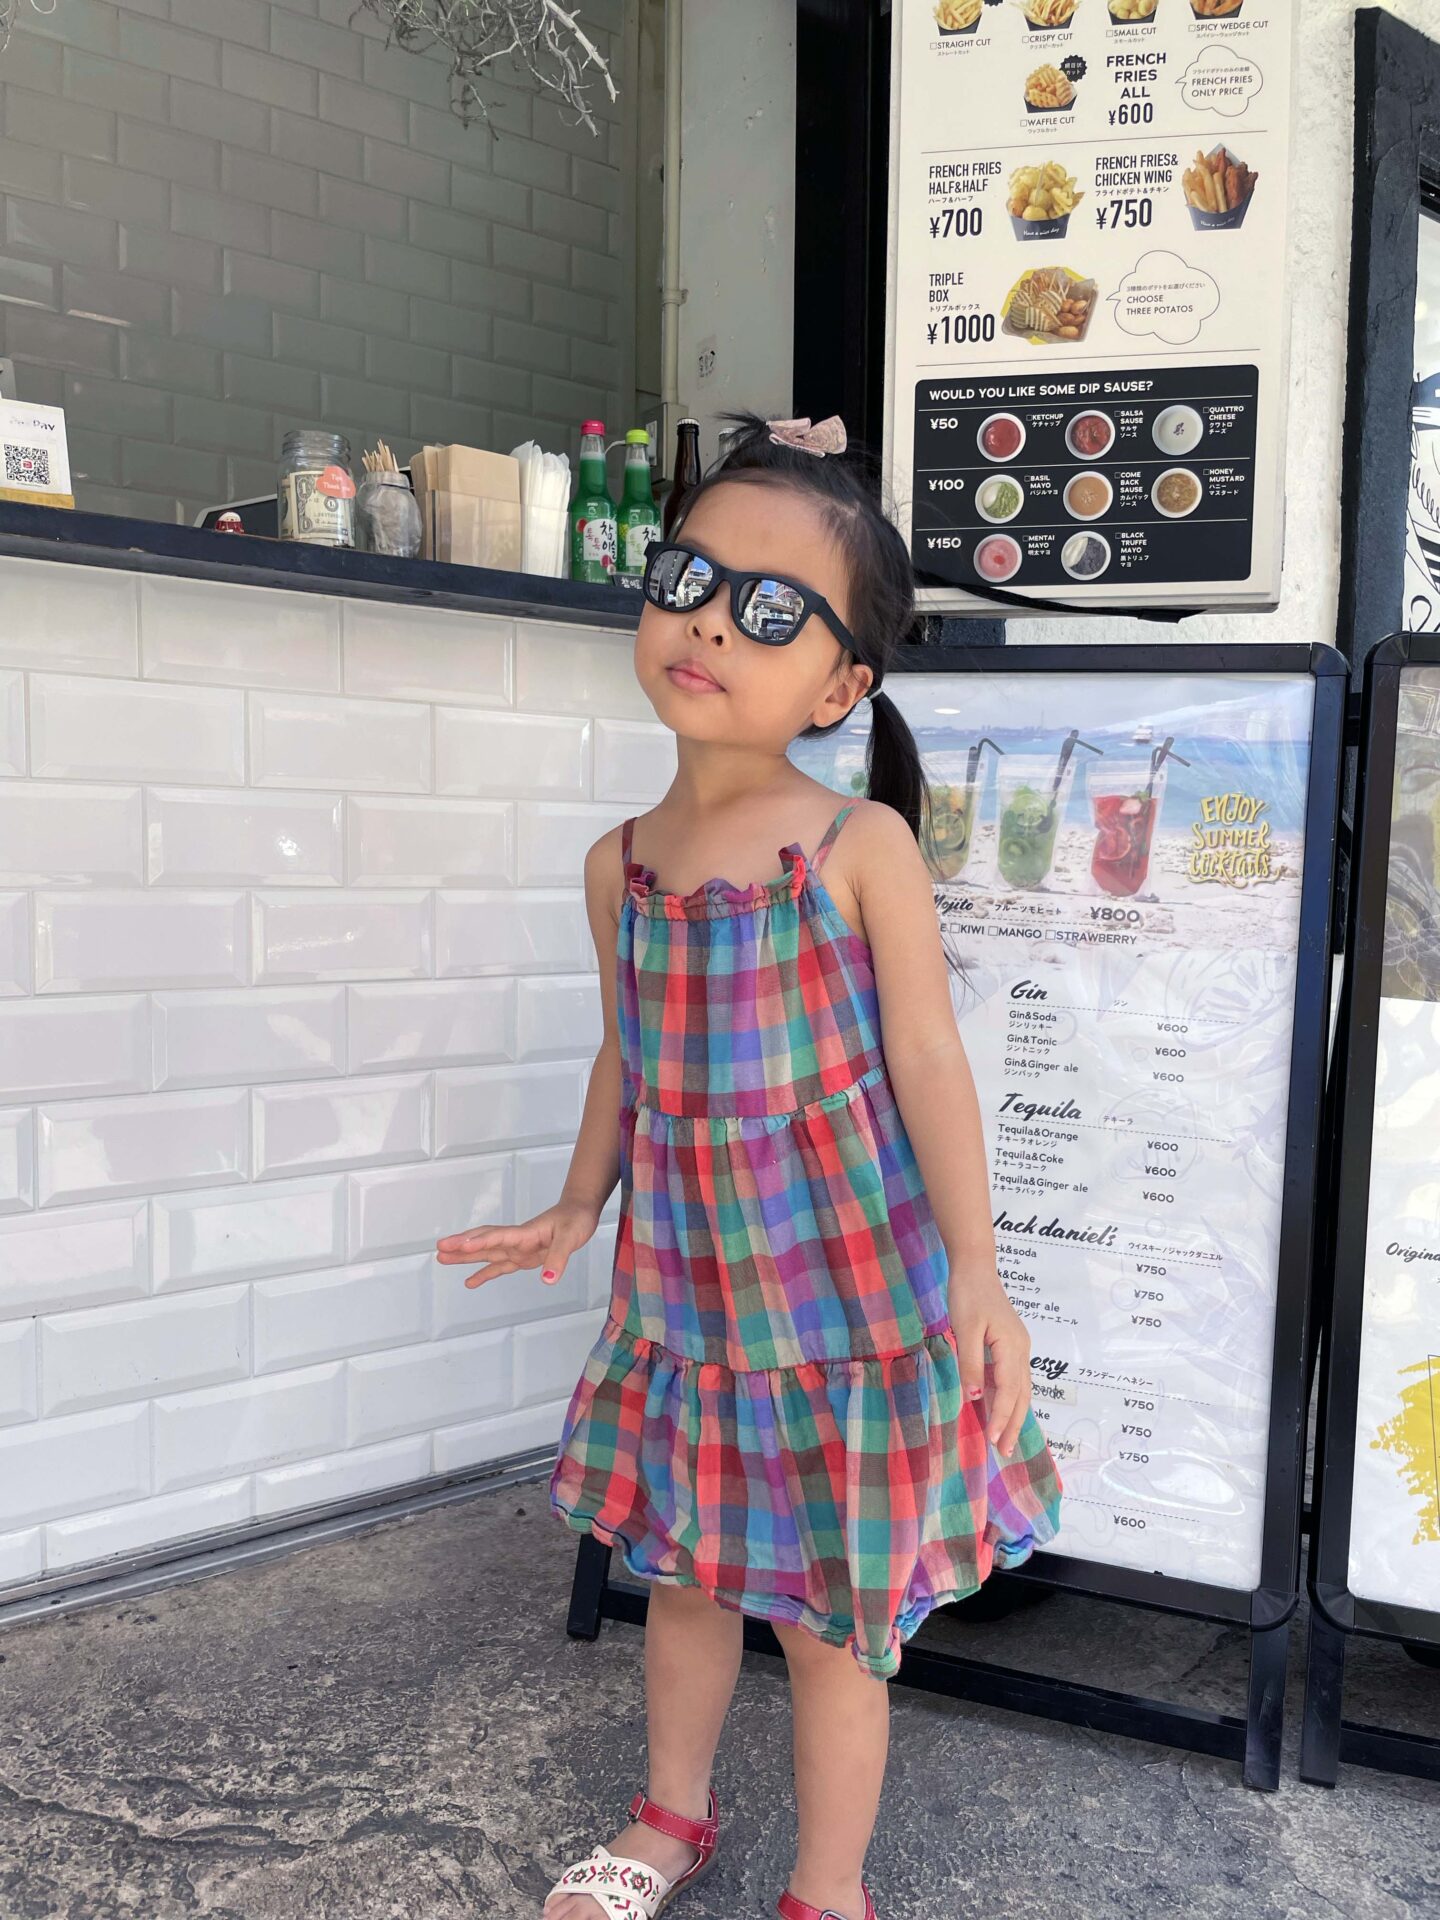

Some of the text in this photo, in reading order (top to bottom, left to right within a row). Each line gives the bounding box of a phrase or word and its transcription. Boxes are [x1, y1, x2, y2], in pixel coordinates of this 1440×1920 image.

[1030, 34, 1055, 43] CRISPY
[1114, 28, 1138, 36] SMALL
[937, 40, 973, 50] STRAIGHT
[1106, 53, 1167, 68] FRENCH
[1115, 69, 1157, 83] FRIES
[1192, 76, 1253, 86] FRENCH FRIES
[1120, 86, 1150, 99] ALL
[1191, 87, 1243, 97] ONLY PRICE
[1109, 102, 1153, 125] ¥600
[1027, 118, 1058, 126] WAFFLE
[1096, 154, 1178, 170] FRENCH FRIES&
[929, 161, 1002, 179] FRENCH FRIES
[1095, 170, 1172, 187] CHICKEN WING
[929, 179, 989, 195] HALF&HALF
[1096, 198, 1152, 230] ¥750
[930, 207, 982, 238] ¥700
[929, 272, 964, 286] TRIPLE
[929, 289, 949, 302] BOX
[1127, 295, 1164, 304] CHOOSE
[1126, 305, 1193, 315] THREE POTATOS
[927, 313, 995, 344] ¥1000
[929, 380, 1154, 400] WOULD YOU LIKE SOME DIP SAUSE?
[930, 418, 958, 430] ¥50
[929, 479, 964, 491] ¥100
[927, 537, 962, 549] ¥150
[1201, 792, 1264, 825] ENJOY
[995, 904, 1061, 915] フルーツモヒート
[1090, 906, 1140, 922] ¥800
[960, 925, 984, 935] KIWI
[999, 927, 1042, 939] MANGO
[1056, 932, 1137, 945] STRAWBERRY
[1010, 979, 1048, 1001] Gin
[1009, 1010, 1057, 1021] Gin&Soda
[1008, 1020, 1052, 1030] ジンリッキー
[1157, 1023, 1188, 1033] ¥600
[1007, 1034, 1057, 1046] Gin&Tonic
[1006, 1045, 1051, 1055] ジントニック
[1155, 1047, 1186, 1058] ¥600
[1004, 1058, 1079, 1073] Gin&Ginger ale
[1153, 1072, 1184, 1082] ¥600
[998, 1092, 1082, 1121] Tequila
[1103, 1115, 1134, 1125] テキーラ
[998, 1124, 1079, 1141] Tequila&Orange
[997, 1135, 1057, 1148] テキーラオレンジ
[1147, 1141, 1179, 1152] ¥600
[996, 1148, 1064, 1164] Tequila&Coke
[995, 1159, 1047, 1172] テキーラコーク
[1145, 1166, 1177, 1177] ¥600
[993, 1173, 1088, 1193] Tequila&Ginger ale
[1142, 1191, 1174, 1203] ¥600
[1038, 1218, 1119, 1248] daniel's
[1136, 1263, 1166, 1276] ¥750
[1134, 1289, 1164, 1301] ¥750
[1044, 1302, 1060, 1312] ale
[1131, 1315, 1162, 1328] ¥750
[1124, 1397, 1154, 1411] ¥750
[1121, 1424, 1152, 1438] ¥750
[1119, 1451, 1149, 1464] ¥750
[1113, 1514, 1146, 1529] ¥600
